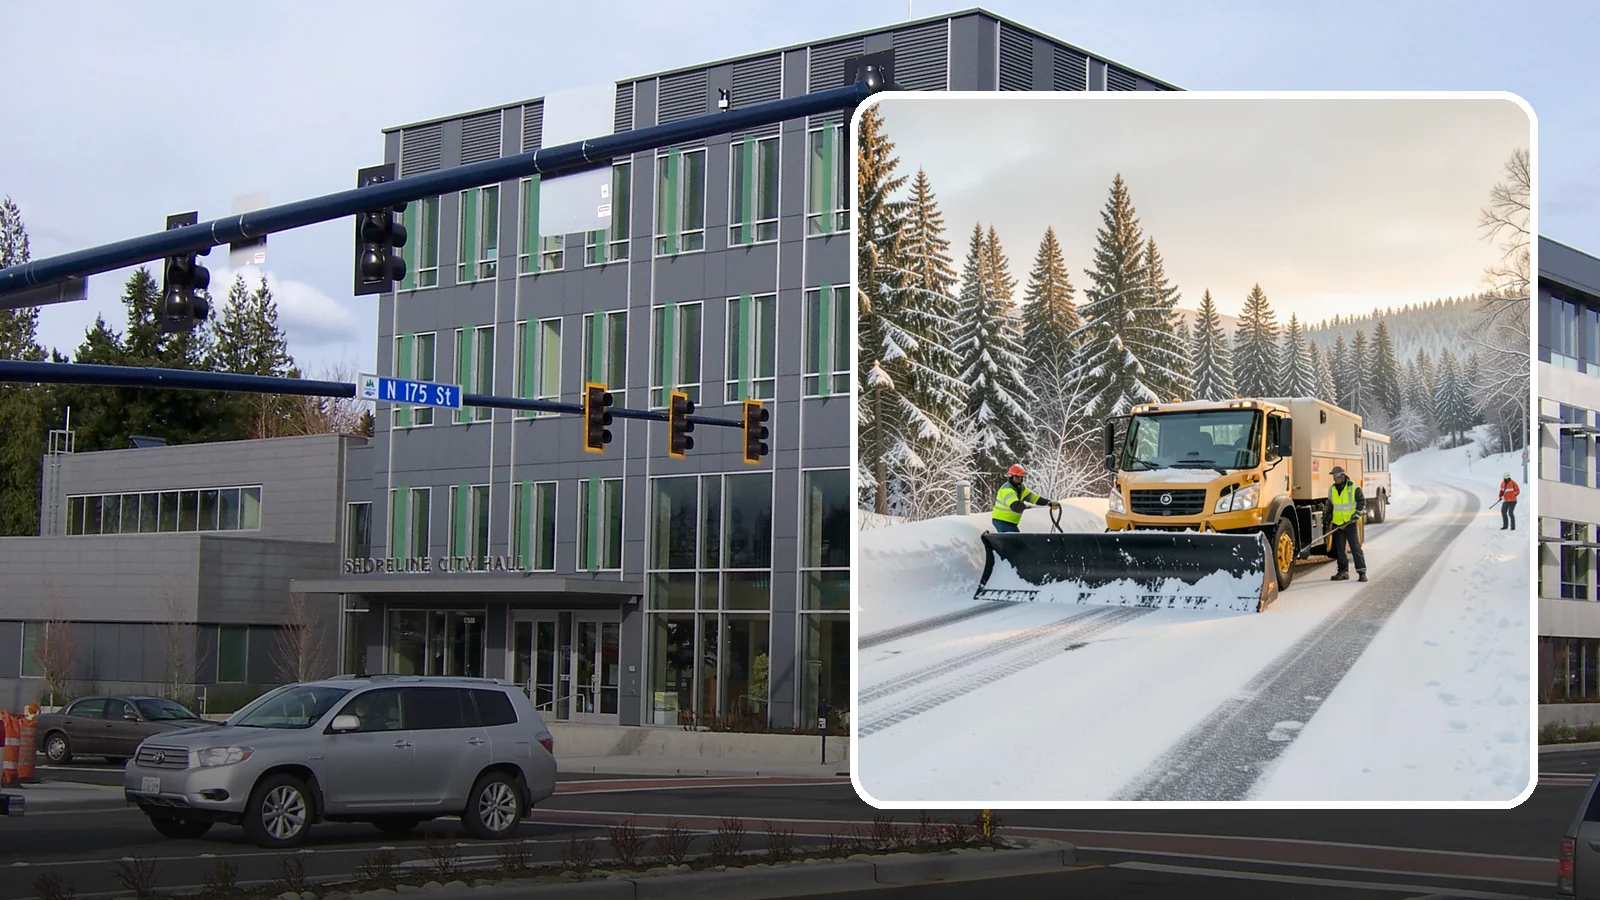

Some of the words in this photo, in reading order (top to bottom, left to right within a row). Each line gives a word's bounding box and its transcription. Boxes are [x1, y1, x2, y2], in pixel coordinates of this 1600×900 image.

[387, 380, 396, 400] N
[405, 382, 427, 403] 175
[436, 386, 451, 405] St
[344, 557, 432, 574] SHORELINE
[438, 556, 477, 573] CITY
[483, 555, 527, 572] HALL
